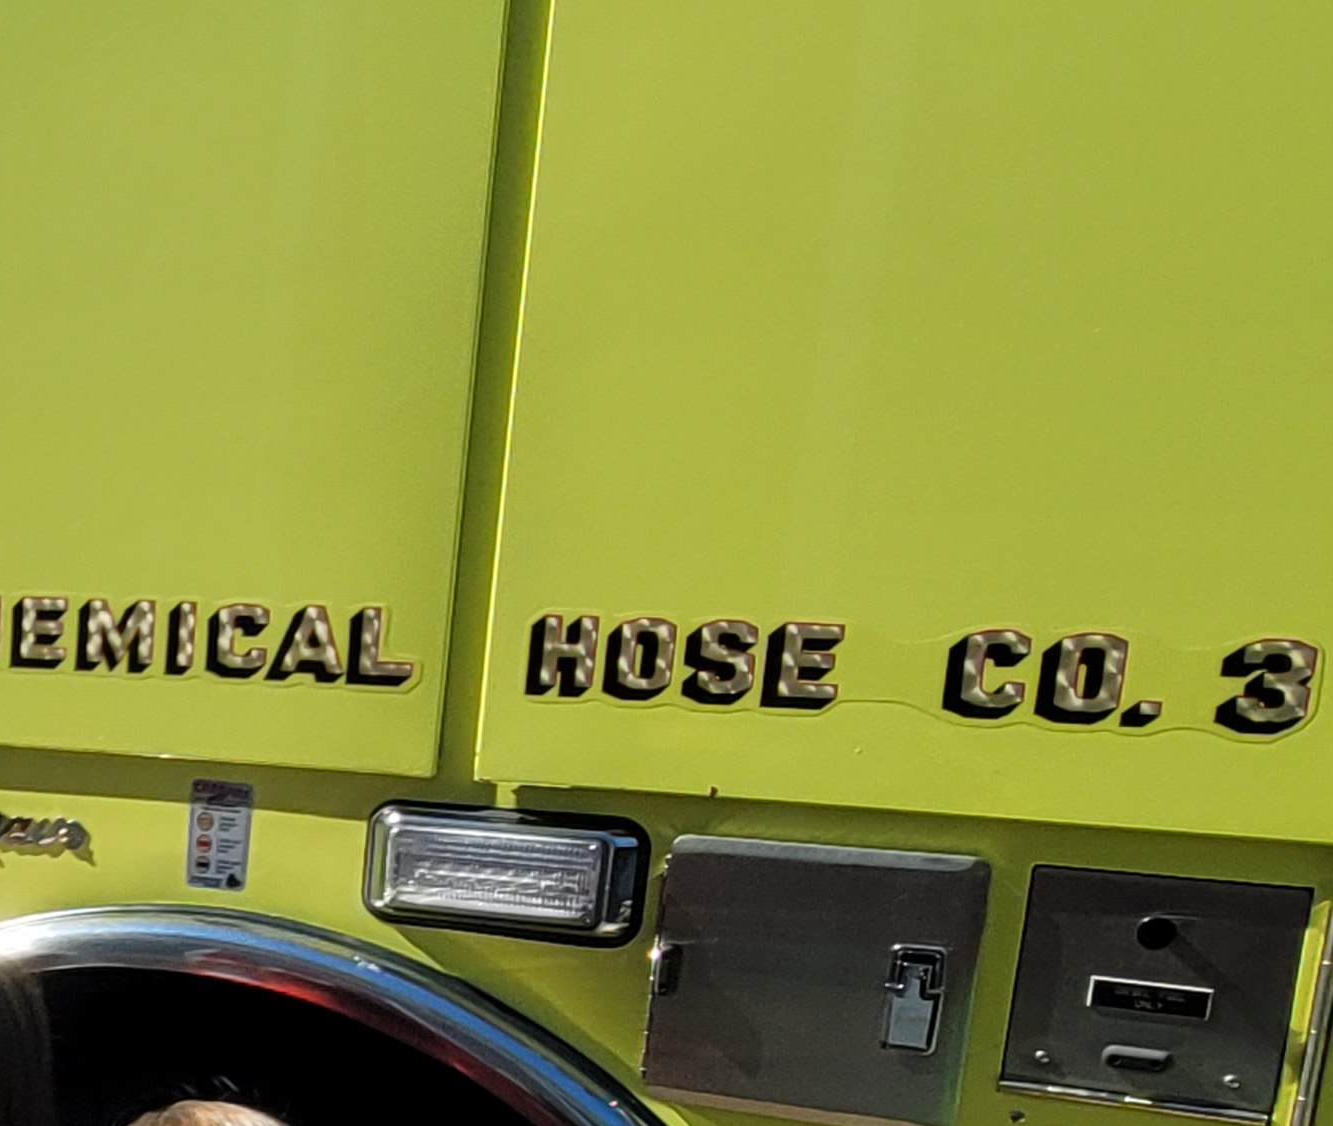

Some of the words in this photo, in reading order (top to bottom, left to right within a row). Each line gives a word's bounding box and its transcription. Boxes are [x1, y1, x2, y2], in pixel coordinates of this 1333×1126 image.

[524, 614, 846, 710] HOSE
[940, 628, 1164, 728] CO.
[1214, 638, 1319, 735] 3
